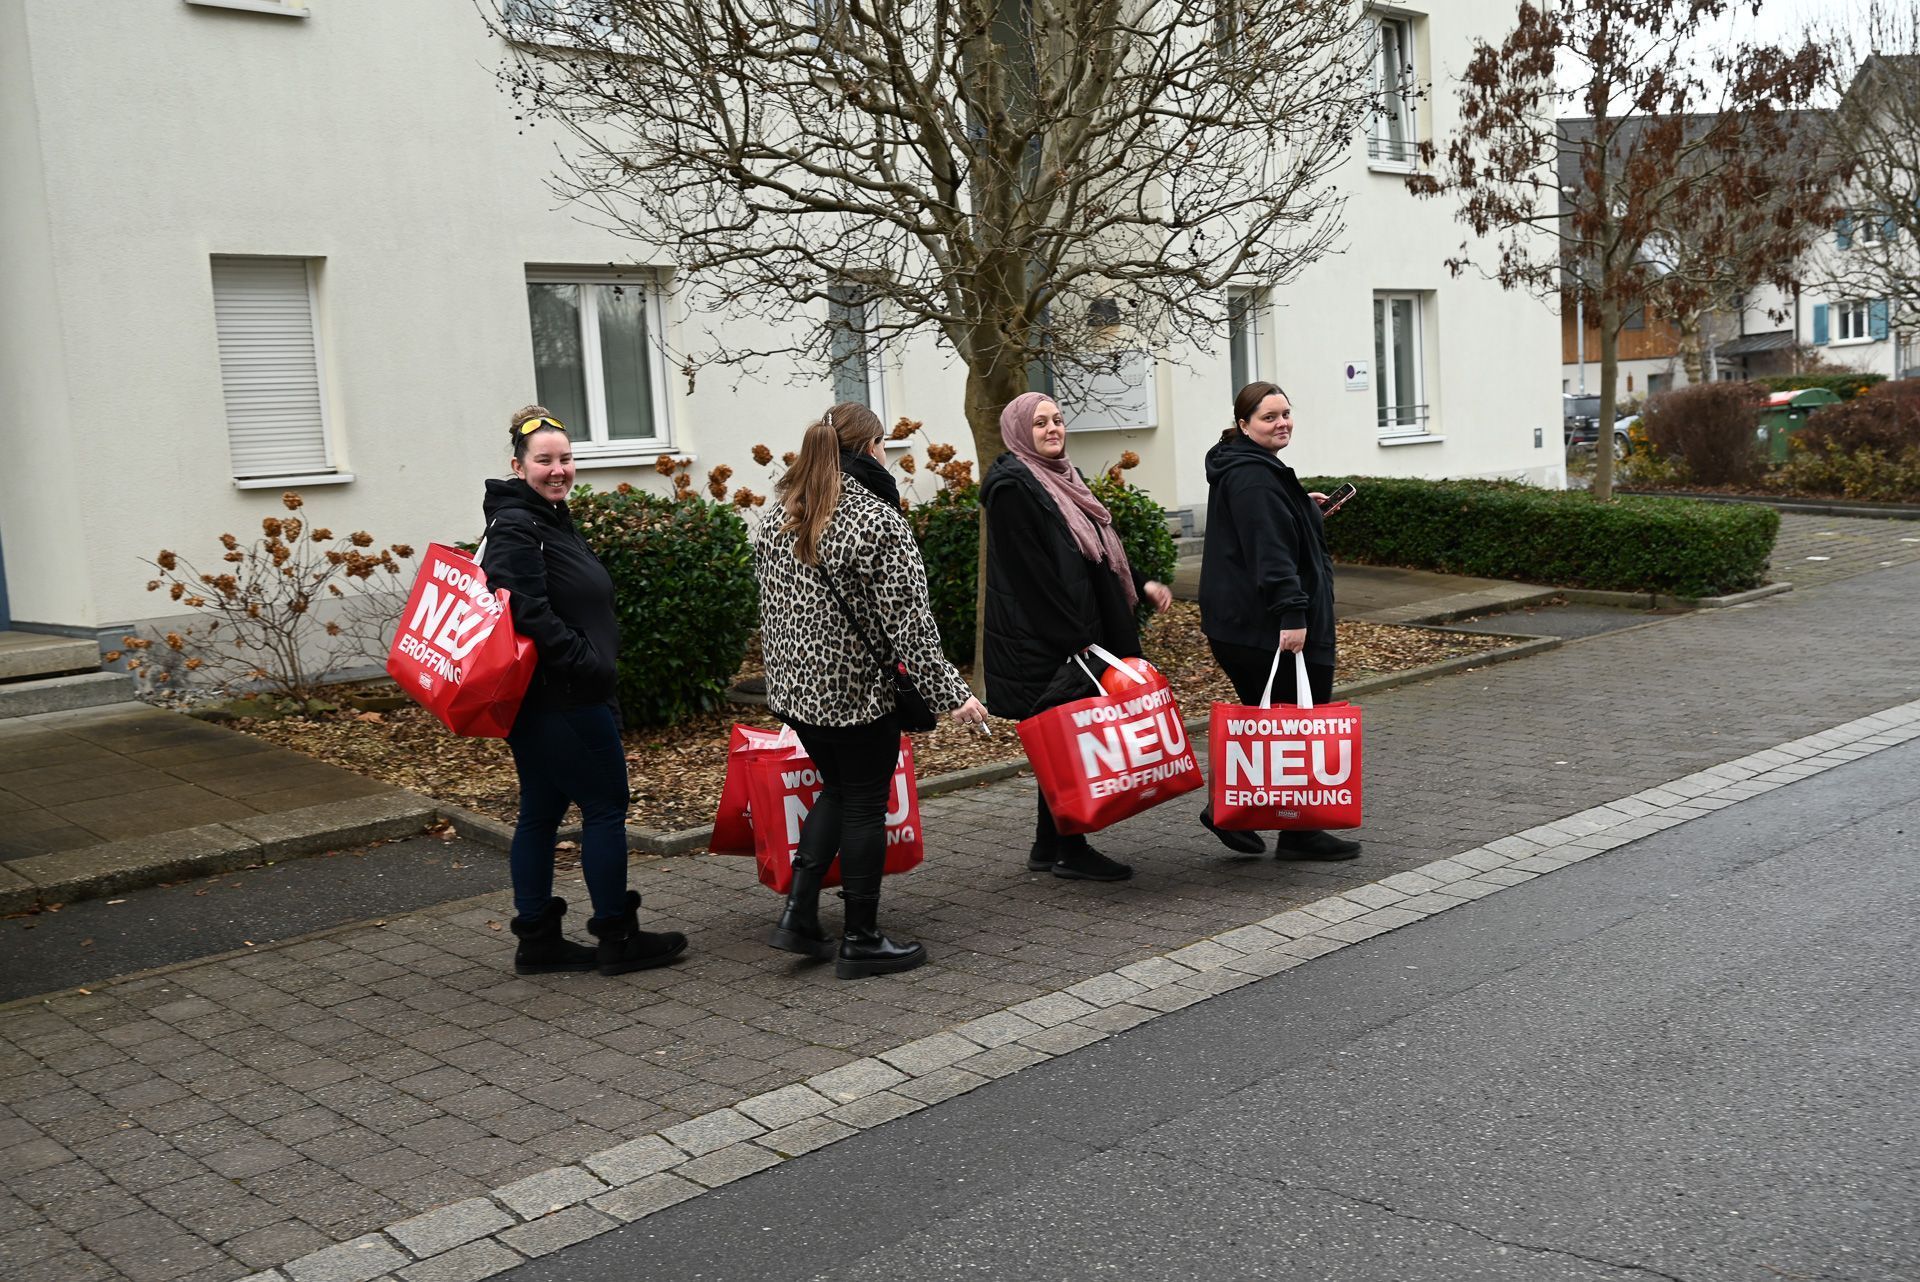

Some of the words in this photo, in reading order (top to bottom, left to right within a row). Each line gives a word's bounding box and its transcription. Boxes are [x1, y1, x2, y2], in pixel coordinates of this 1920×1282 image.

[409, 581, 495, 660] NEU
[1076, 707, 1186, 779] NEU
[1225, 739, 1352, 786] NEU
[1088, 755, 1194, 799] ERÖFFNUNG
[1225, 787, 1352, 806] ERÖFFNUNG
